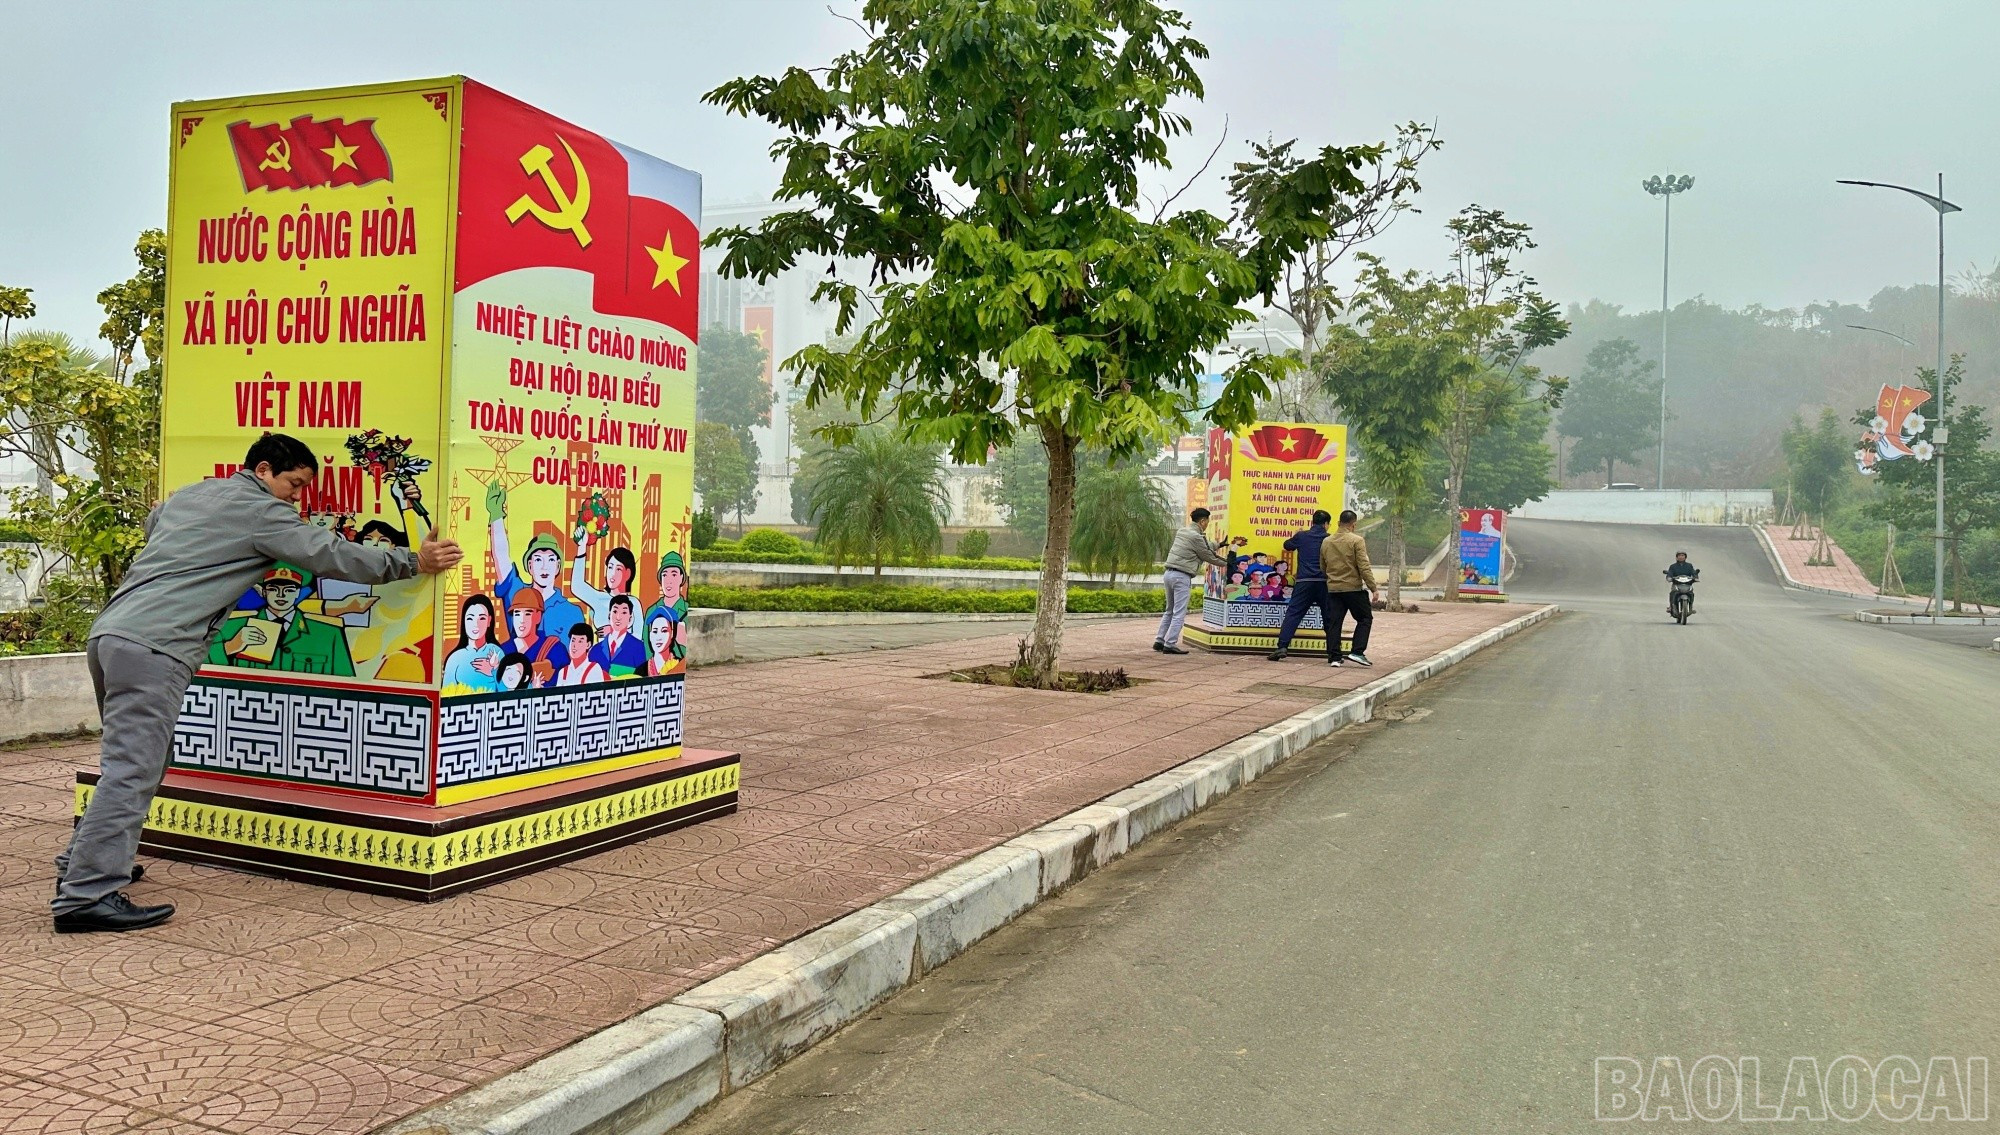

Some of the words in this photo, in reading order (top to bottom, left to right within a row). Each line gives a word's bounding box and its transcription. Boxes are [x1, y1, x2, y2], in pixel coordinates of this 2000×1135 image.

[197, 206, 269, 264] NƯỚC
[278, 203, 352, 271] CỘNG
[360, 196, 417, 257] HÒA
[182, 291, 217, 346] XÃ
[224, 289, 268, 355] HỘI
[276, 280, 330, 345] CHỦ
[339, 285, 427, 343] NGHĨA
[476, 301, 537, 345] NHIỆT
[543, 315, 582, 354] LIỆT
[588, 326, 634, 361] CHÀO
[640, 335, 687, 371] MỪNG
[235, 371, 291, 436] VIỆT
[298, 380, 362, 428] NAM
[509, 357, 543, 395] ĐẠI
[550, 362, 582, 400] HỘI
[587, 372, 617, 406] ĐẠI
[623, 371, 661, 408] BIỂU
[468, 398, 524, 435] TOÀN
[530, 403, 582, 441] QUỐC
[588, 409, 622, 446] LẦN
[628, 418, 660, 450] THỨ
[663, 427, 688, 453] XIV
[301, 455, 363, 514] NĂM
[374, 466, 382, 515] !
[532, 446, 572, 486] CỦA
[577, 450, 626, 490] ĐẢNG
[632, 465, 638, 491] !
[1260, 517, 1272, 525] VAI
